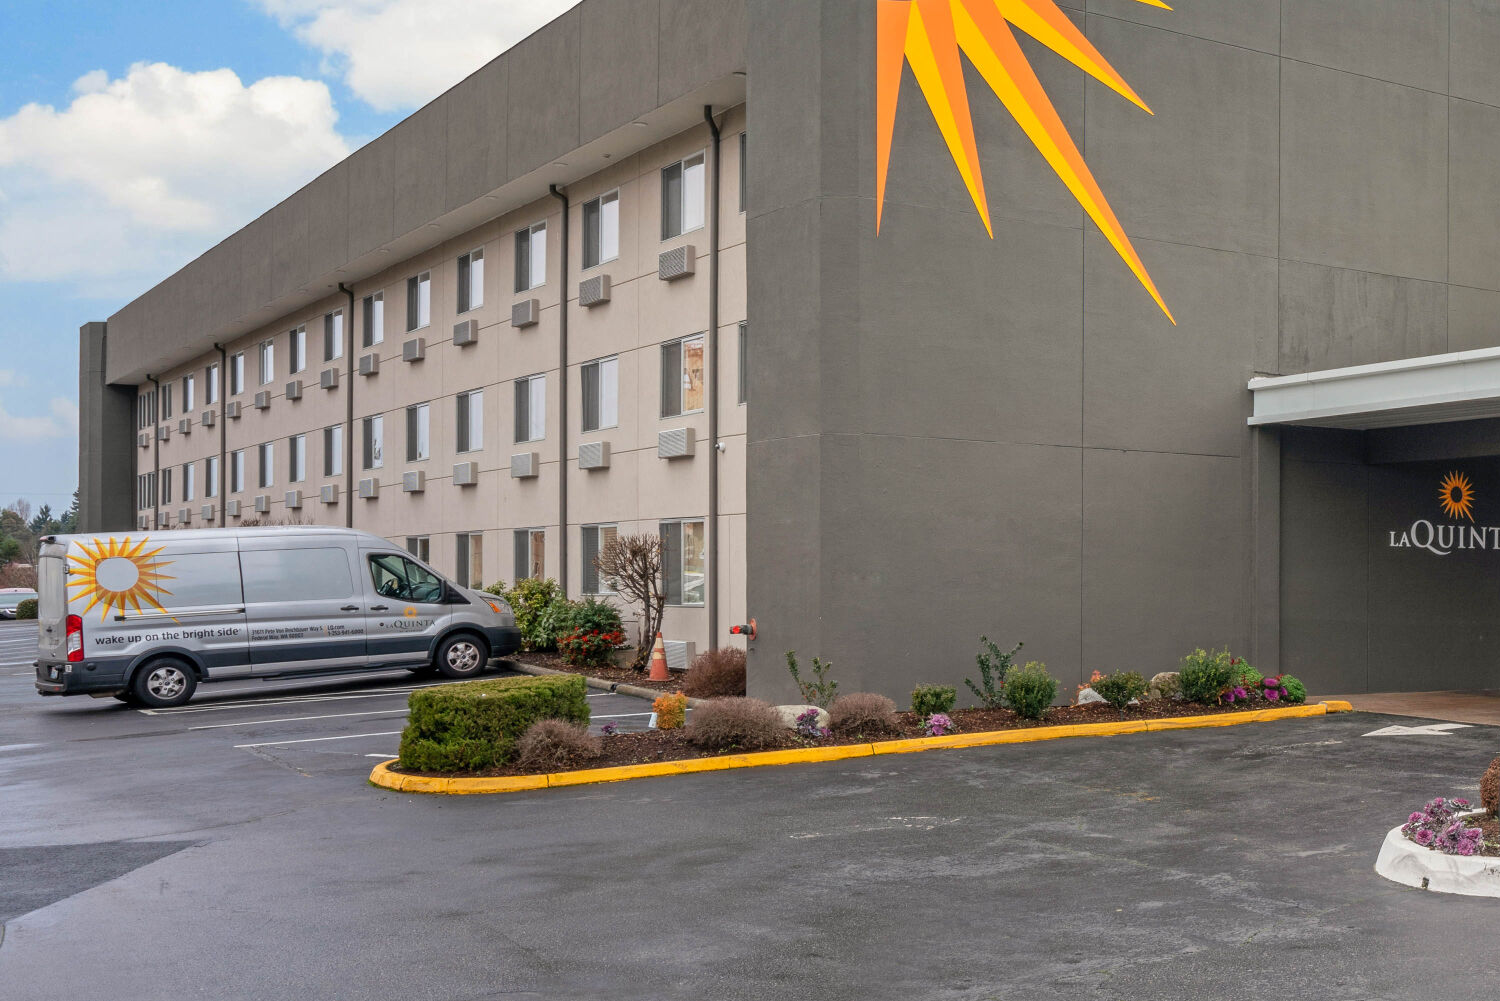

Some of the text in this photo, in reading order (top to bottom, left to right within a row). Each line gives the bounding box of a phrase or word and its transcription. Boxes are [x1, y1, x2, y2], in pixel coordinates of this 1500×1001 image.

[95, 627, 239, 645] wake up on the bright side
